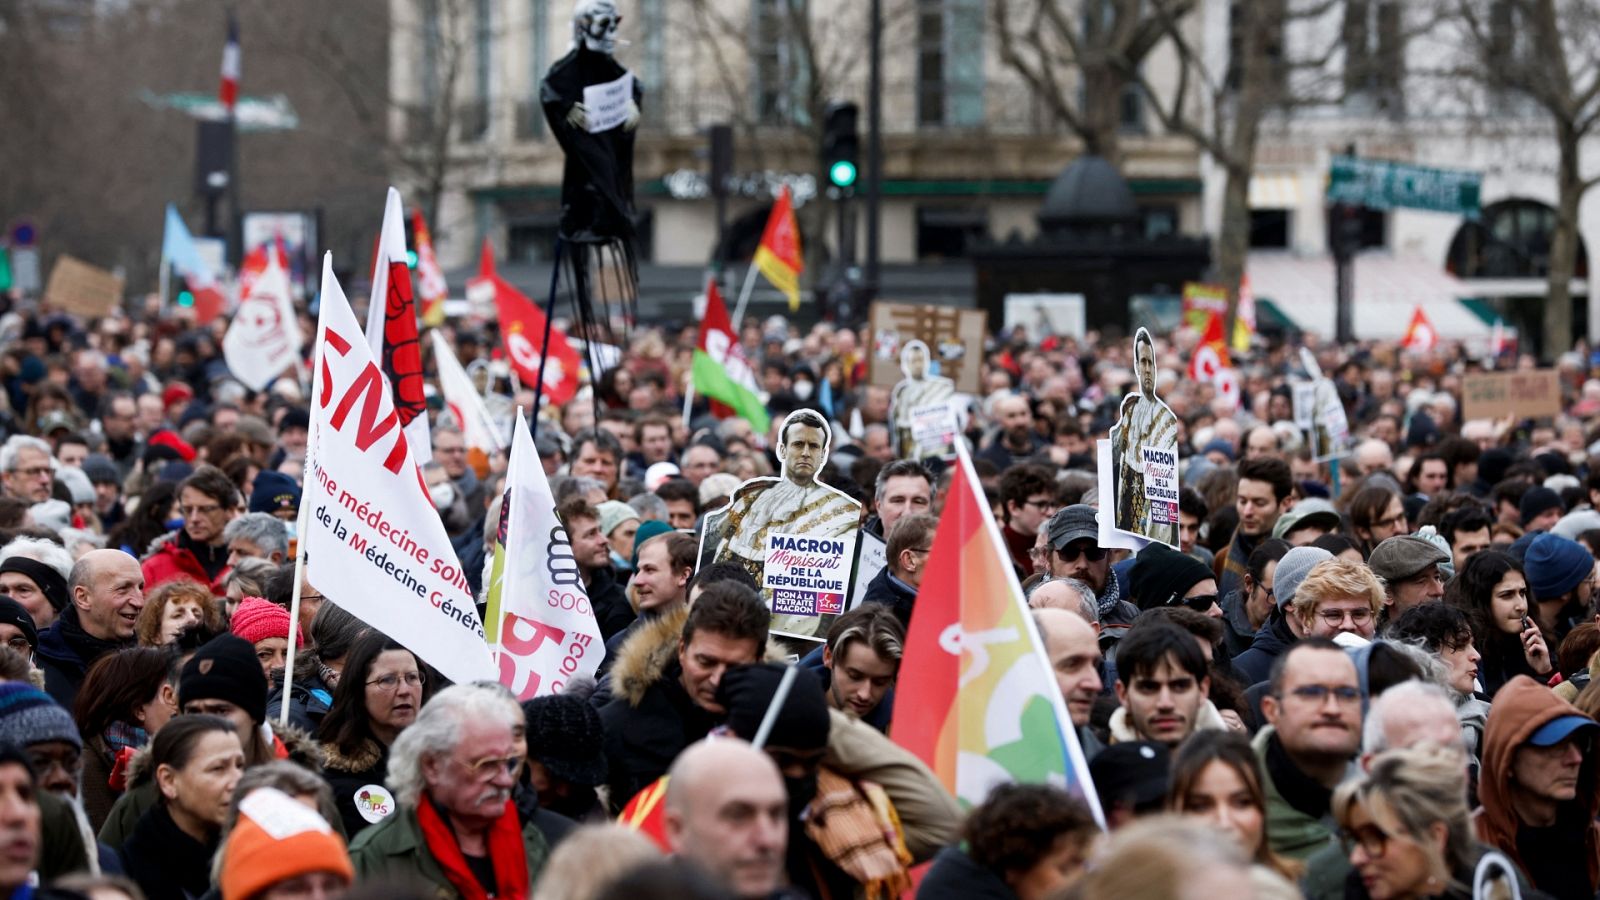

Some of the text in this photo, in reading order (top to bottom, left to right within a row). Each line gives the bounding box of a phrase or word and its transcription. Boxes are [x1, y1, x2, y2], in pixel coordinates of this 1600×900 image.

[1143, 449, 1174, 465] MACRON
[1155, 478, 1169, 488] DE LA
[1146, 485, 1177, 499] RÉPUBLIQUE
[338, 489, 429, 564] médecine
[316, 505, 332, 528] de
[333, 518, 348, 541] la
[349, 532, 427, 598] Médecine
[771, 536, 844, 555] MACRON
[766, 549, 842, 571] Méprisant
[790, 567, 822, 578] DE LA
[767, 573, 843, 591] RÉPUBLIQUE
[548, 589, 595, 618] SOCI
[776, 590, 815, 601] NON À LA
[776, 598, 814, 607] RETRAITE
[775, 605, 814, 614] MACRON
